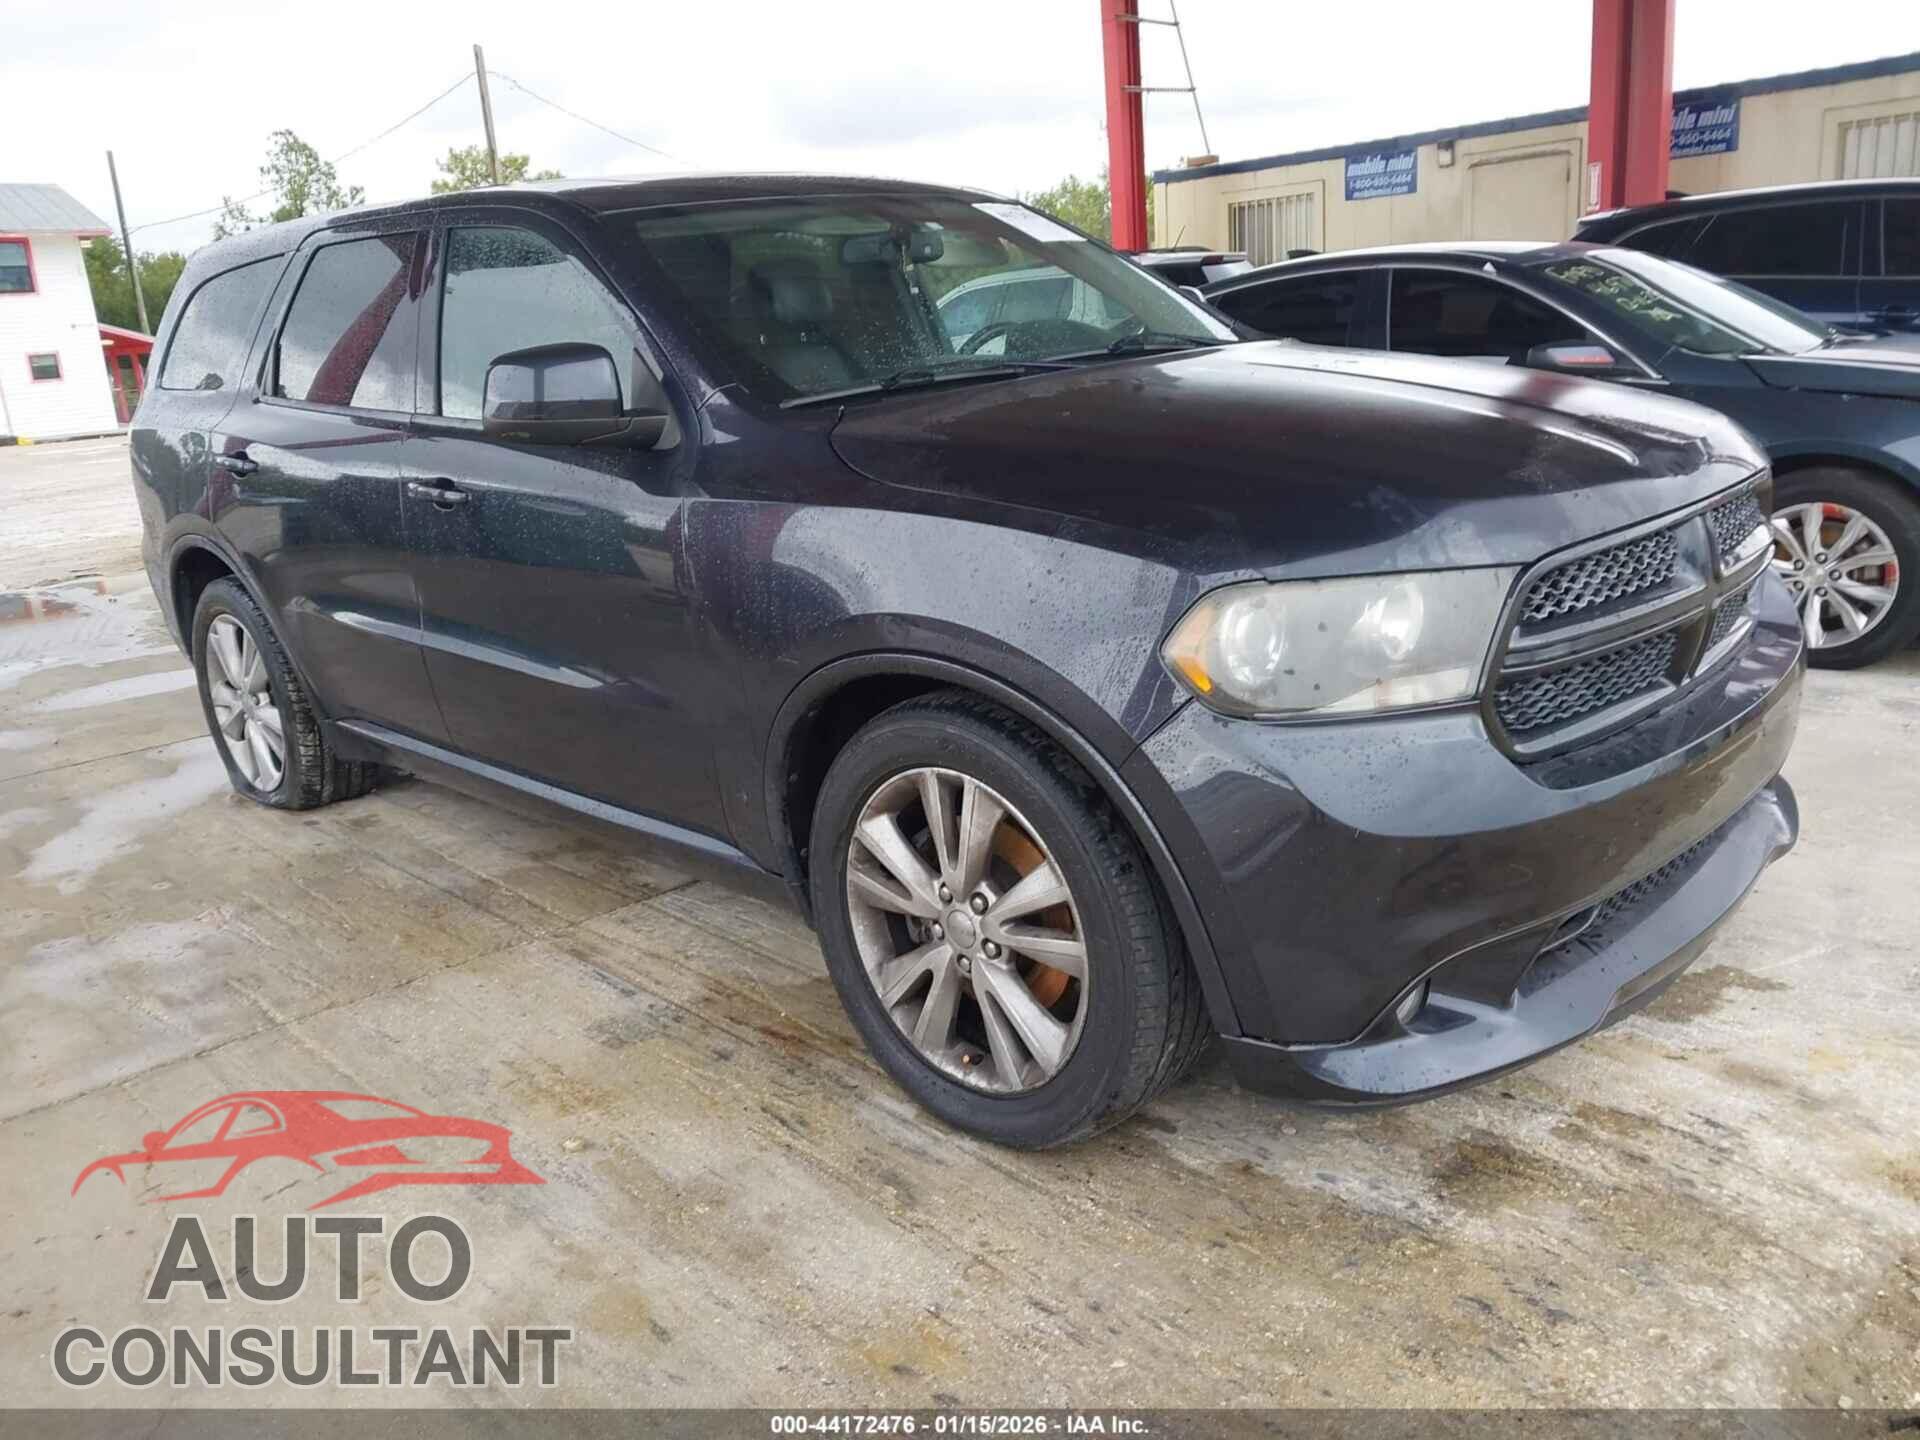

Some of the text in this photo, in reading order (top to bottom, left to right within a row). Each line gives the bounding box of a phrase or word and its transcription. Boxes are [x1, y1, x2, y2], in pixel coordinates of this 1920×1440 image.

[1697, 104, 1737, 127] mini
[1347, 152, 1416, 177] mobile mini
